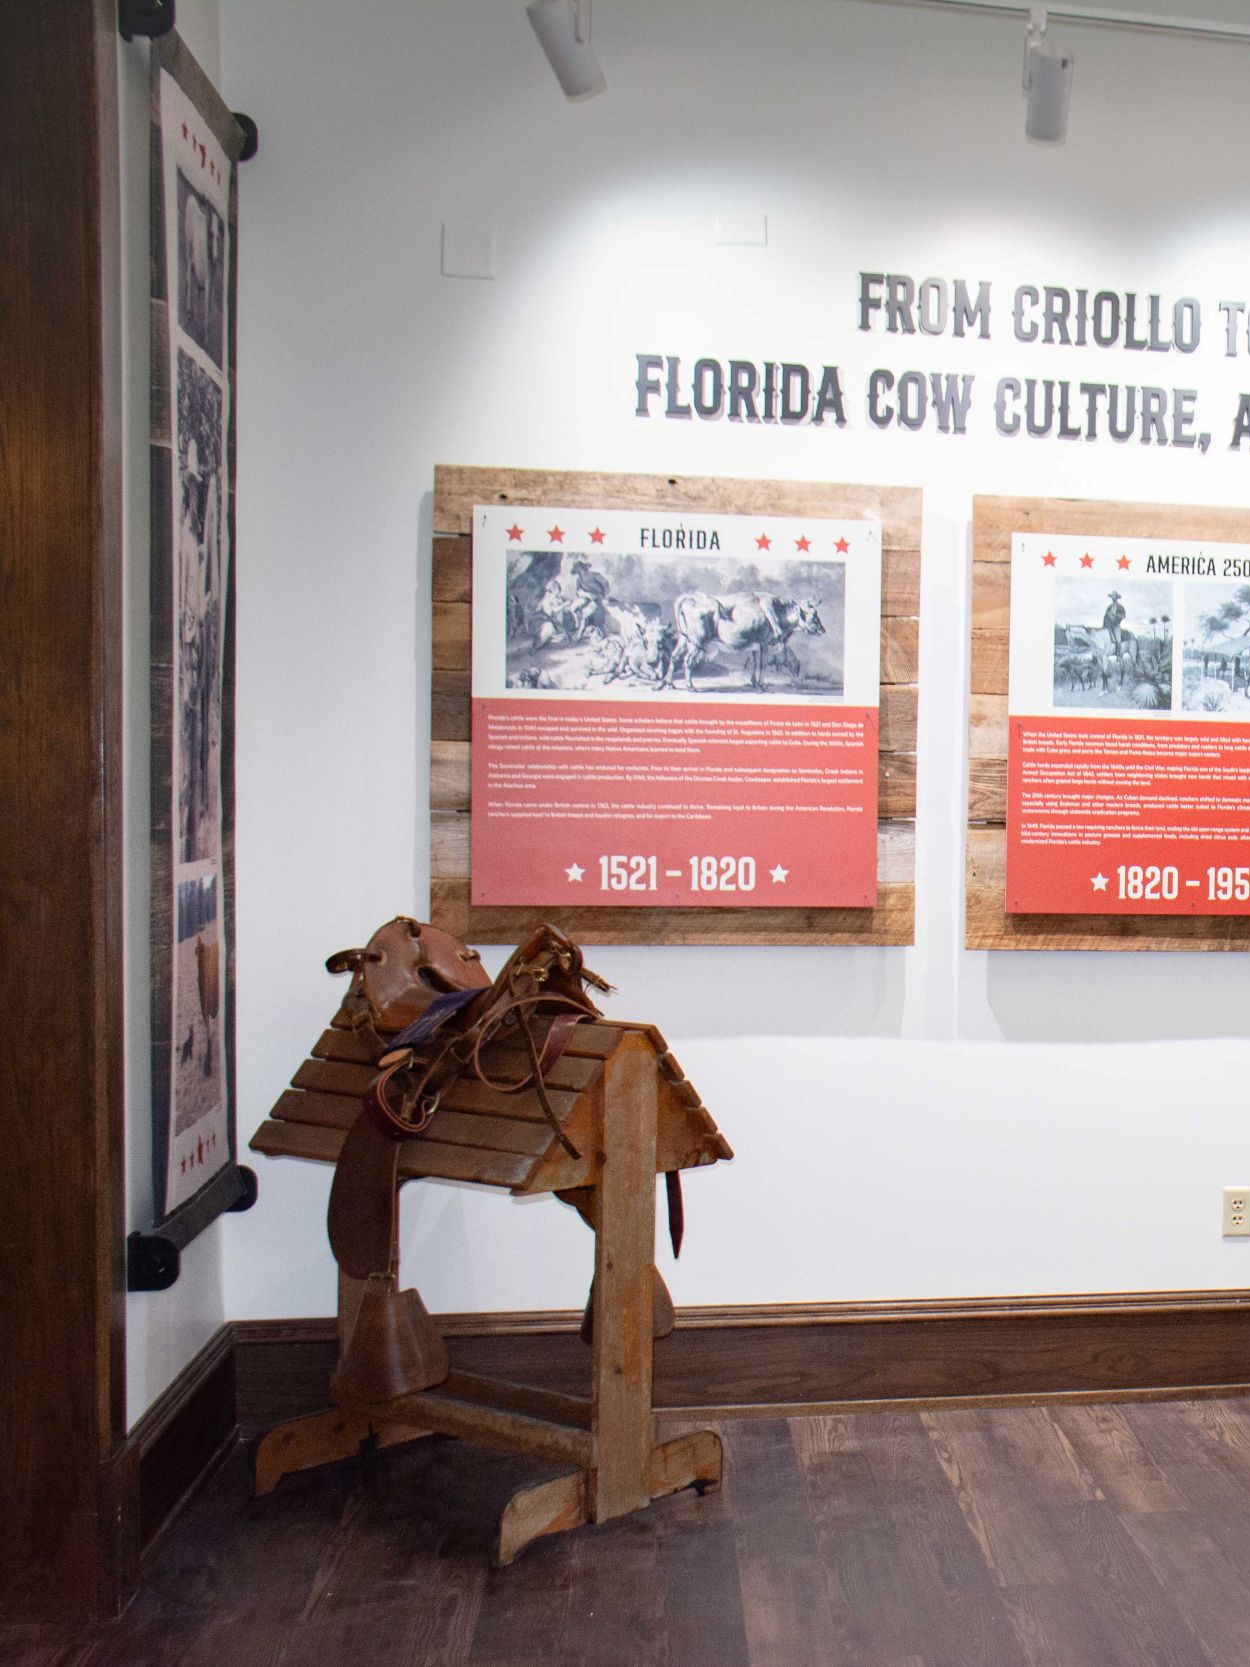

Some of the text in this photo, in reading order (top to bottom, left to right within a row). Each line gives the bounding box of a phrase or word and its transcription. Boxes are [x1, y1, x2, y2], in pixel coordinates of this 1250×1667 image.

[858, 271, 992, 340] FROM
[1012, 284, 1200, 354] CRIOLLO
[634, 353, 847, 429] FLORIDA
[867, 367, 975, 435] COW
[994, 376, 1211, 456] CULTURE,
[640, 528, 721, 551] FLORIDA
[1146, 554, 1217, 577] AMERICA
[598, 855, 658, 892] 1521
[689, 856, 756, 893] 1820
[1117, 865, 1179, 900] 1820
